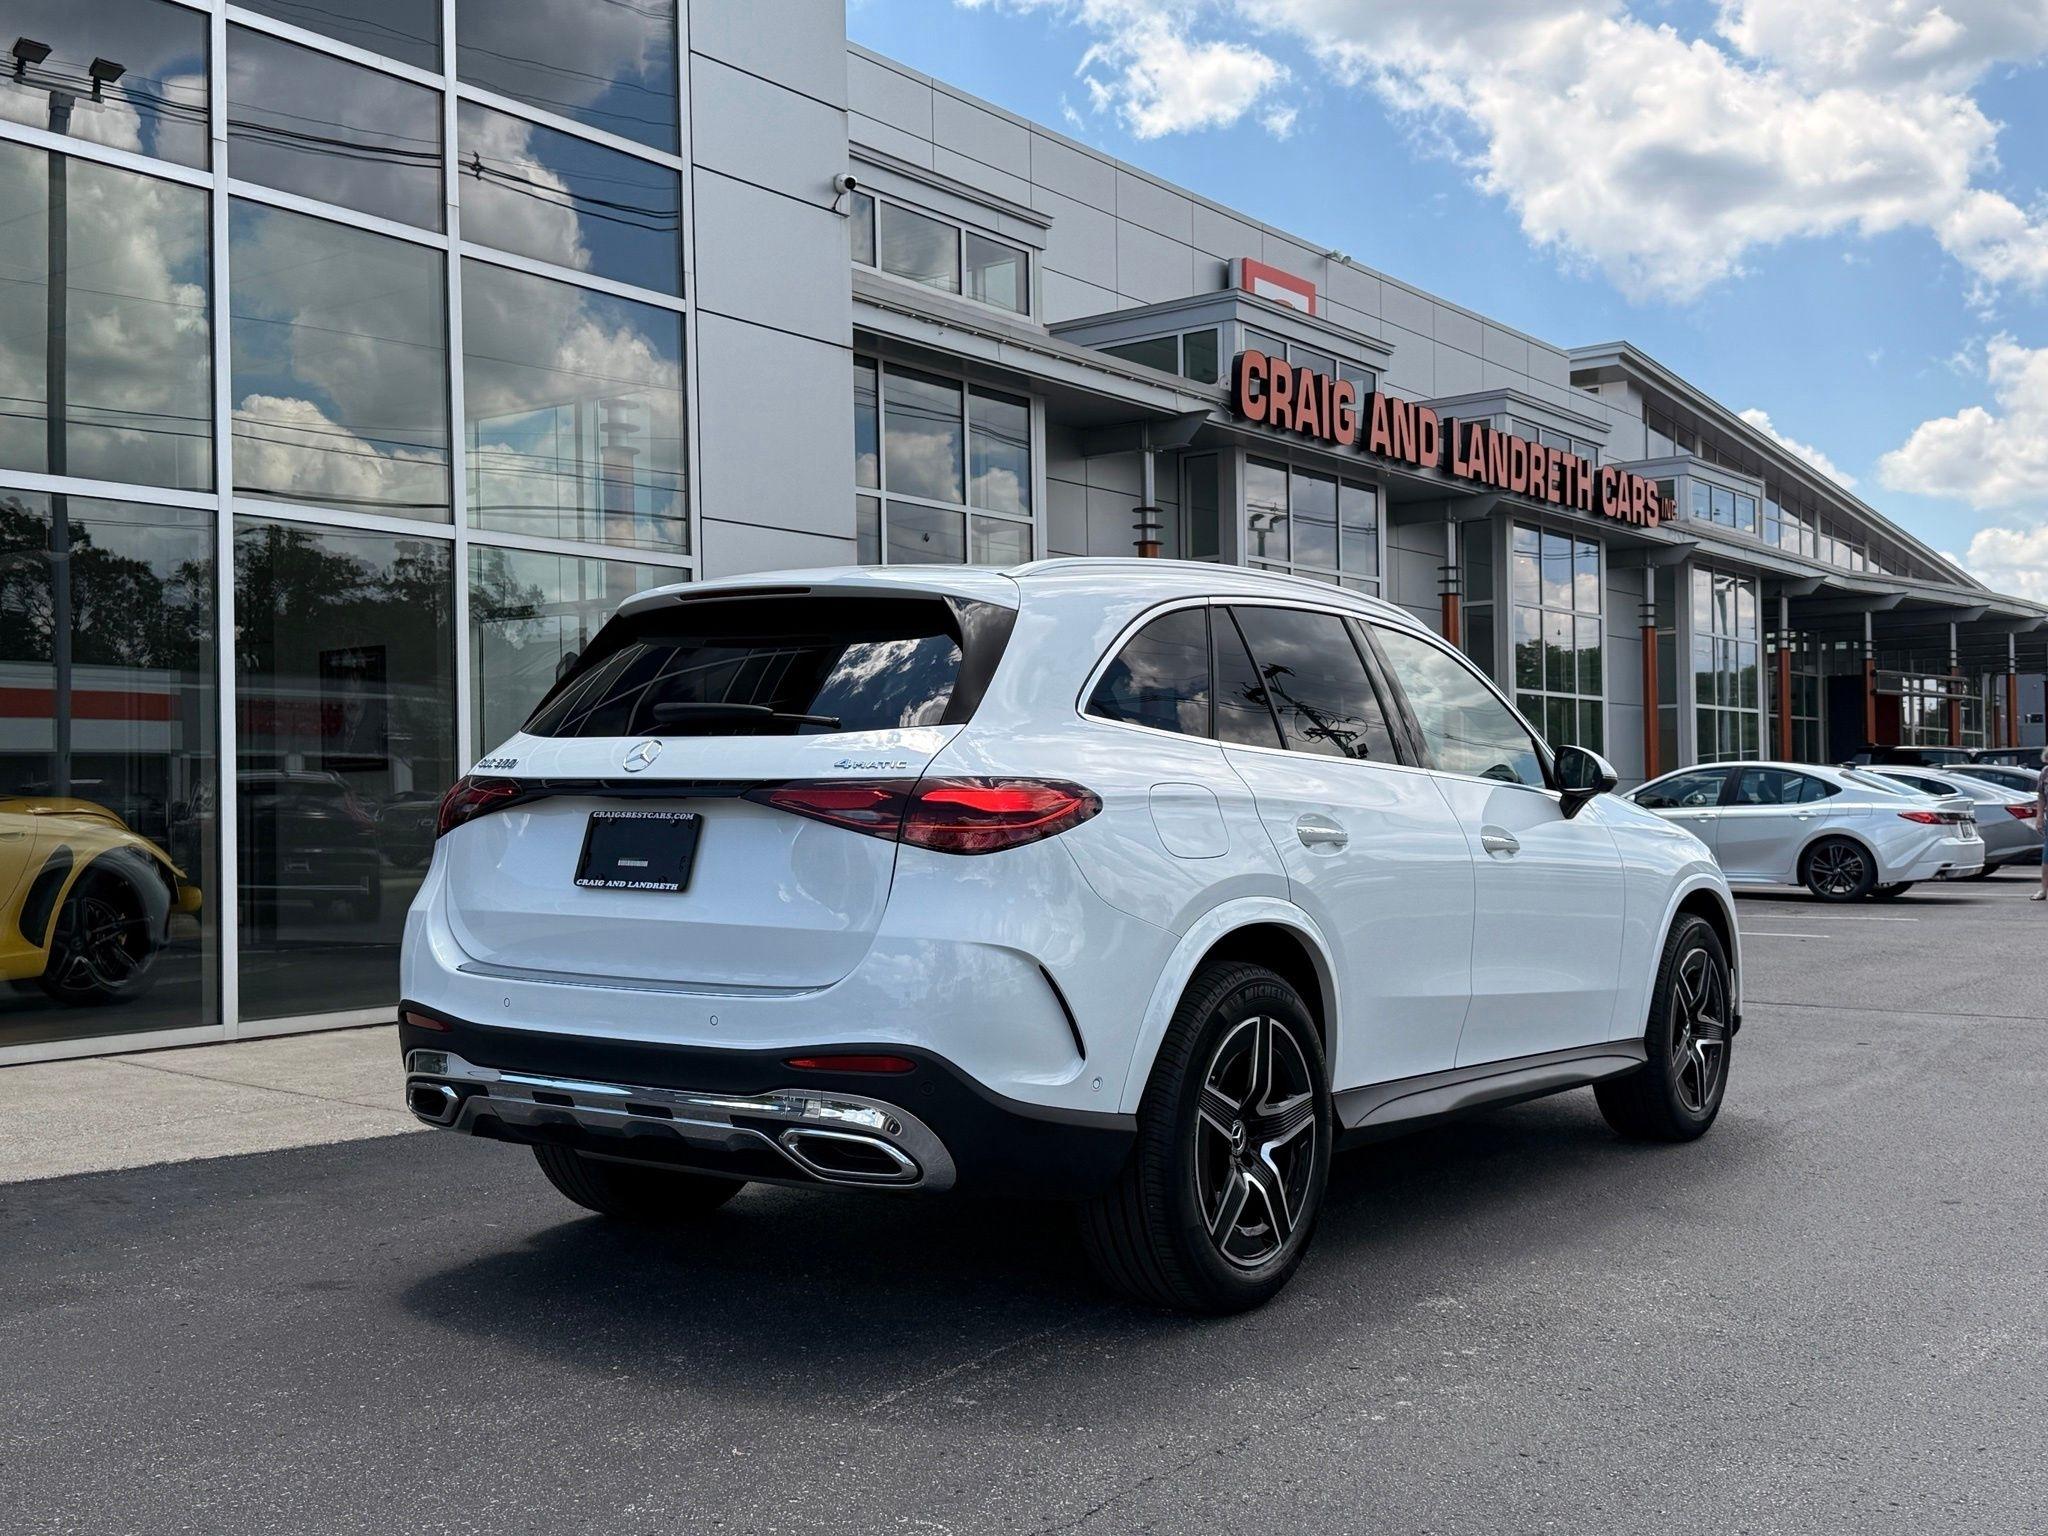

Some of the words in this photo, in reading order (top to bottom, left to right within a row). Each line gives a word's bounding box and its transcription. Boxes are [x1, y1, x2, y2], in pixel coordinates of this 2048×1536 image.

[1240, 349, 1357, 446] CRAIG
[1369, 391, 1439, 469] AND
[1451, 416, 1593, 512] LANDRETH
[1601, 464, 1660, 528] CARS
[833, 758, 908, 770] 4MATIC
[593, 811, 695, 820] CRAIGSBESTCARS.COM
[576, 879, 605, 887] CRAIG
[606, 880, 626, 888] AND
[627, 881, 679, 890] LANDRETH
